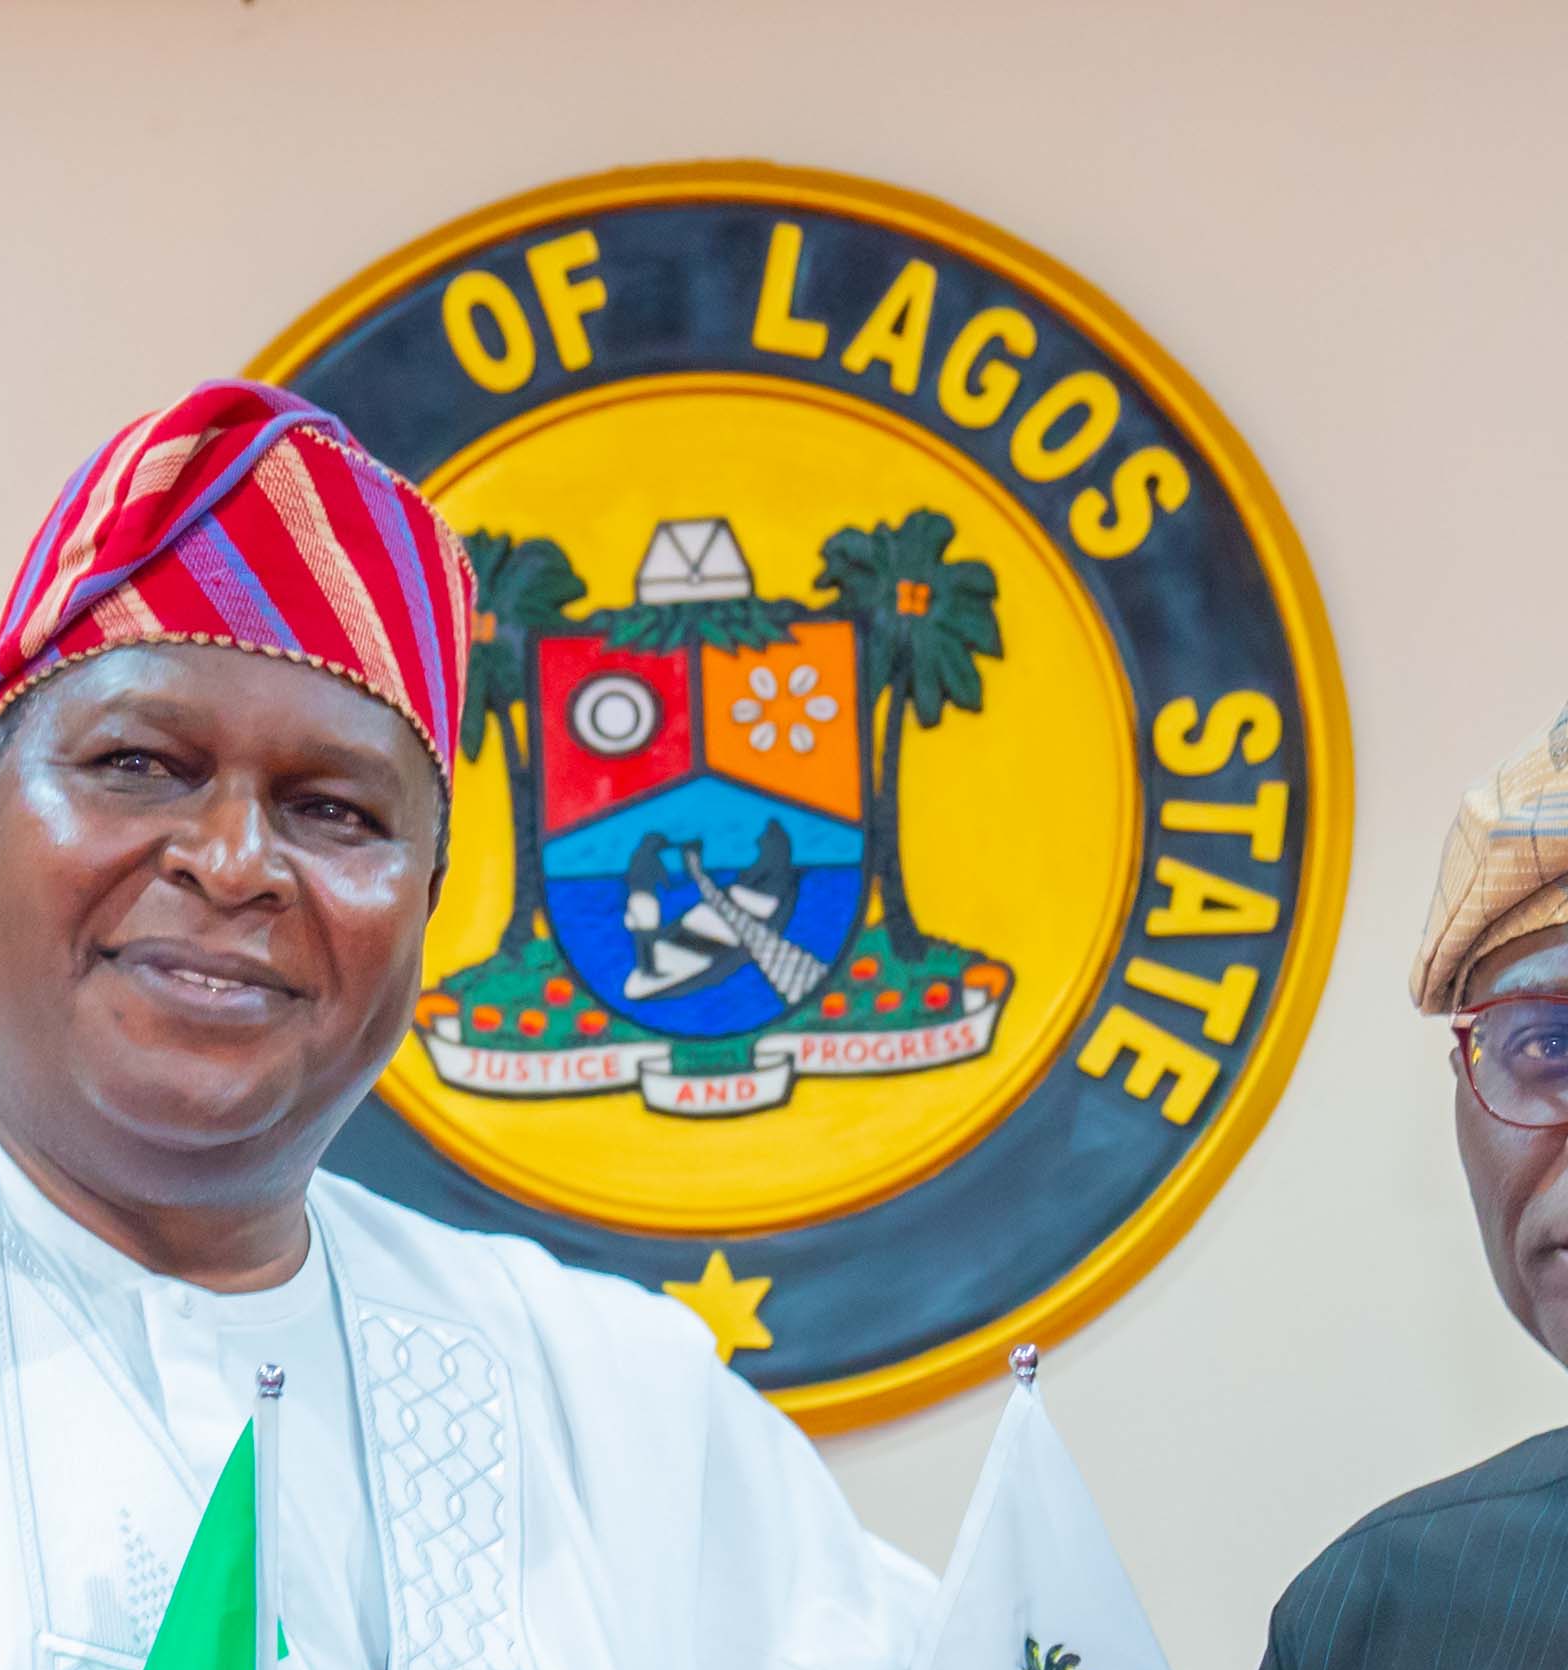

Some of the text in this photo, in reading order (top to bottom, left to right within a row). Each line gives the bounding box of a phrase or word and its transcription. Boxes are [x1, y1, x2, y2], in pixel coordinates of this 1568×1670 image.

[442, 221, 1290, 1126] OF LAGOS STATE
[462, 1023, 978, 1105] JUSTICE AND PROGRESS
